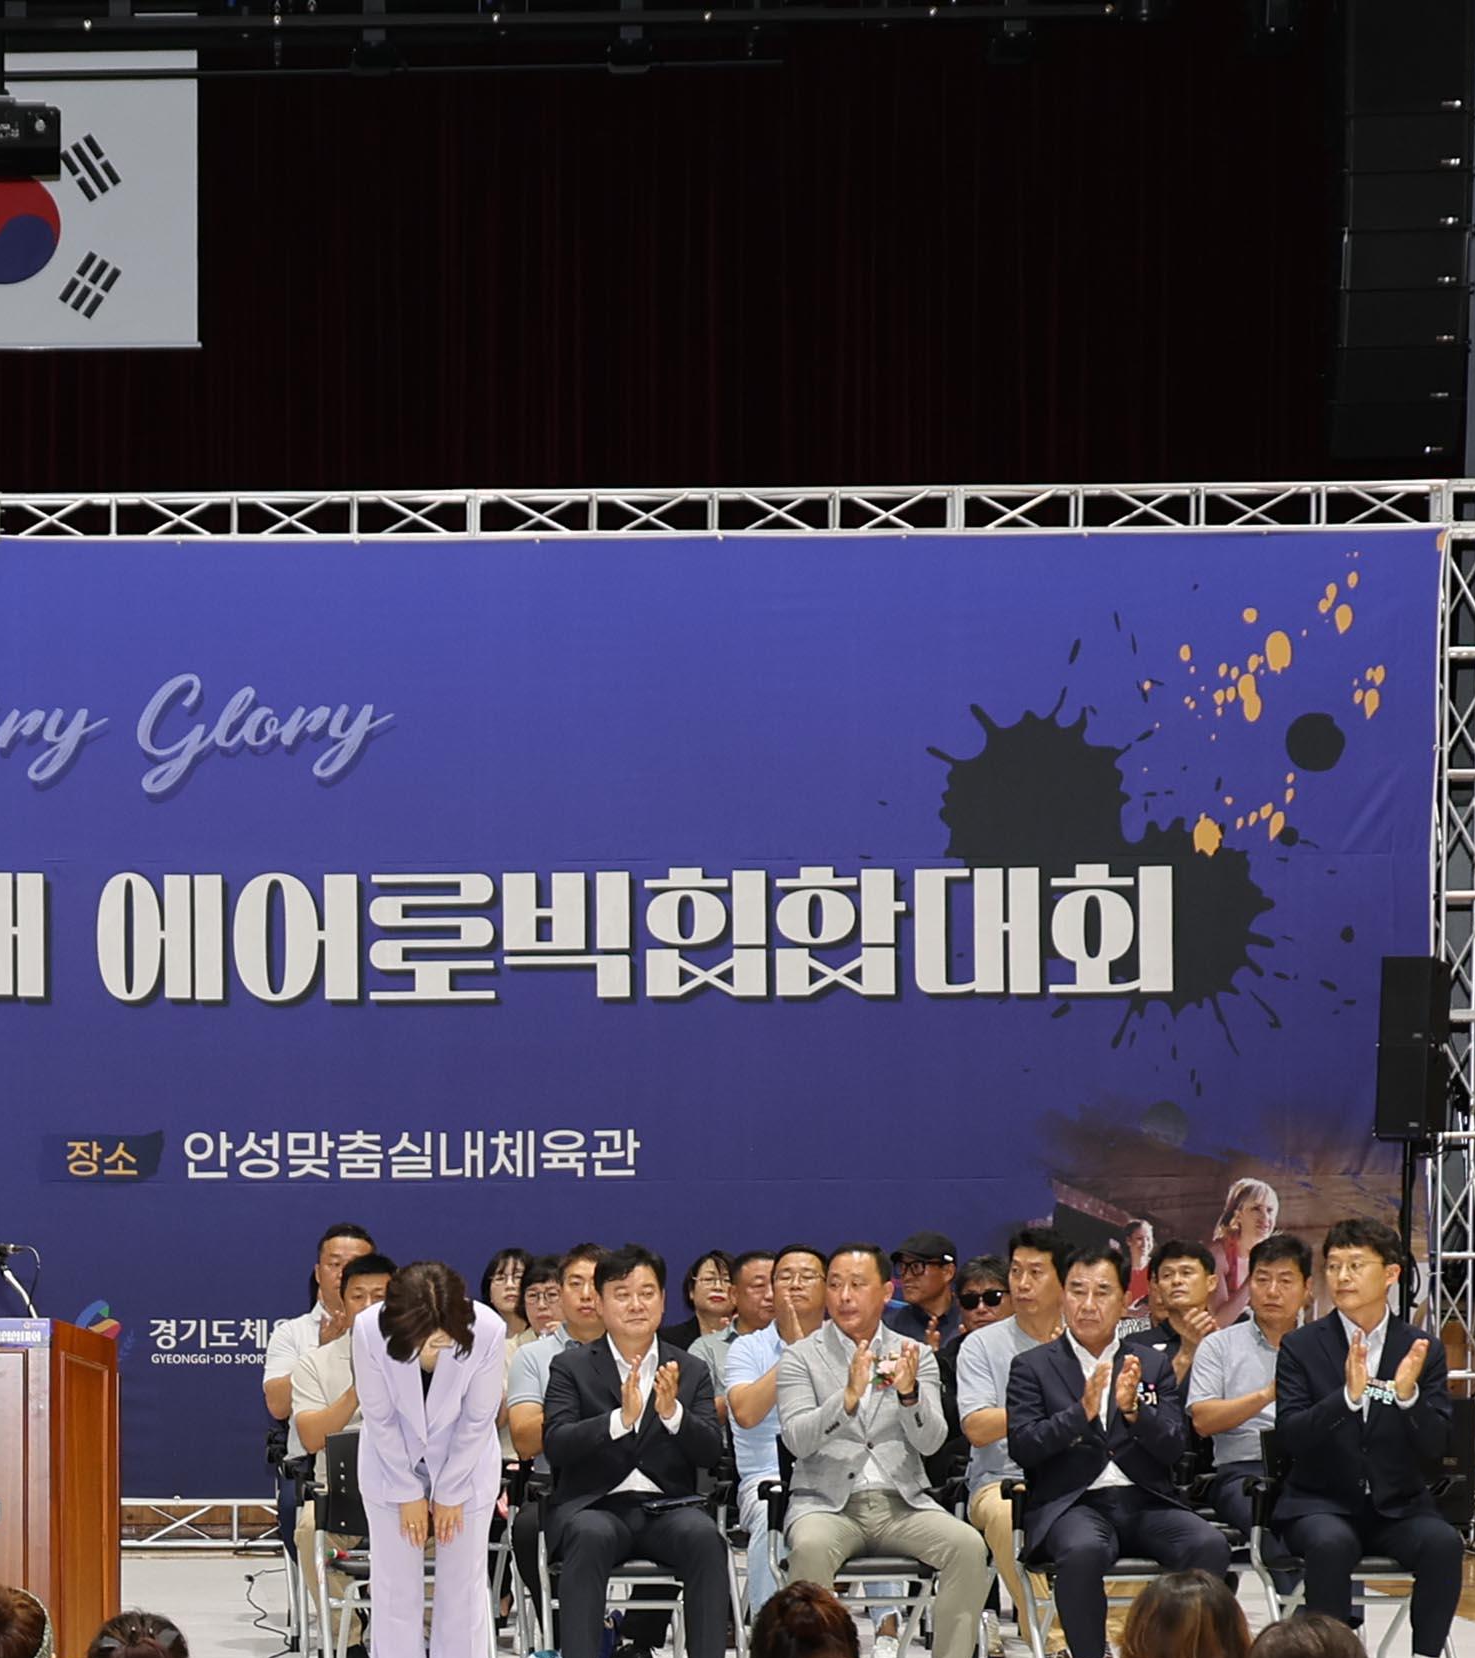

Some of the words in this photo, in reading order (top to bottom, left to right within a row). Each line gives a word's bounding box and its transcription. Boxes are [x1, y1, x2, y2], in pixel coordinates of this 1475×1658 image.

[136, 673, 395, 794] Glory
[97, 863, 1174, 1001] 에어로빅힙합대회
[66, 1140, 138, 1176] 장소
[184, 1129, 641, 1179] 안성맞춤실내체육관
